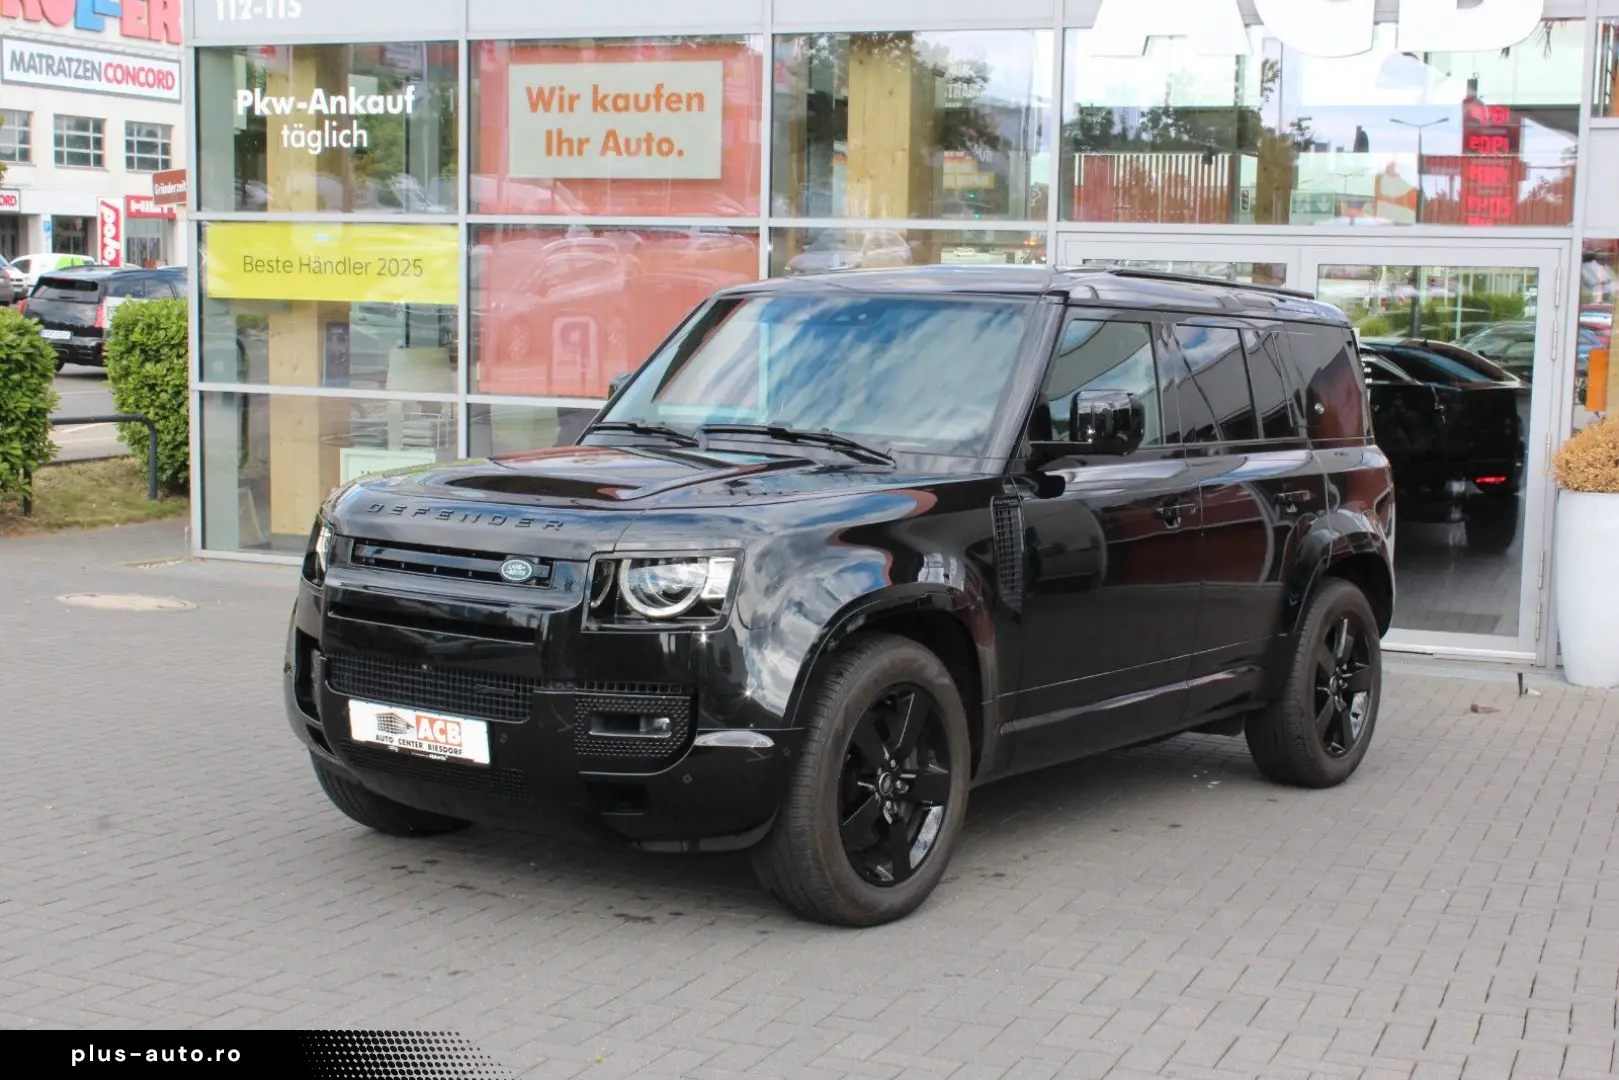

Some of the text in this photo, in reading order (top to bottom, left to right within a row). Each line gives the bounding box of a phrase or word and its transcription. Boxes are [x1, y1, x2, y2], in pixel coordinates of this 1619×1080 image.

[10, 50, 176, 91] MATRATZEN CONCORD
[236, 85, 416, 116] Pkw-Ankauf
[525, 83, 705, 114] Wir kaufen
[281, 120, 368, 155] täglich
[545, 127, 685, 158] Ihr Auto.
[243, 255, 424, 278] Beste Händler 2025
[367, 503, 565, 531] DEFENDER
[375, 734, 394, 744] AUTO
[398, 738, 424, 749] CENTER
[427, 744, 463, 756] BIESDORF
[417, 715, 461, 745] ACB
